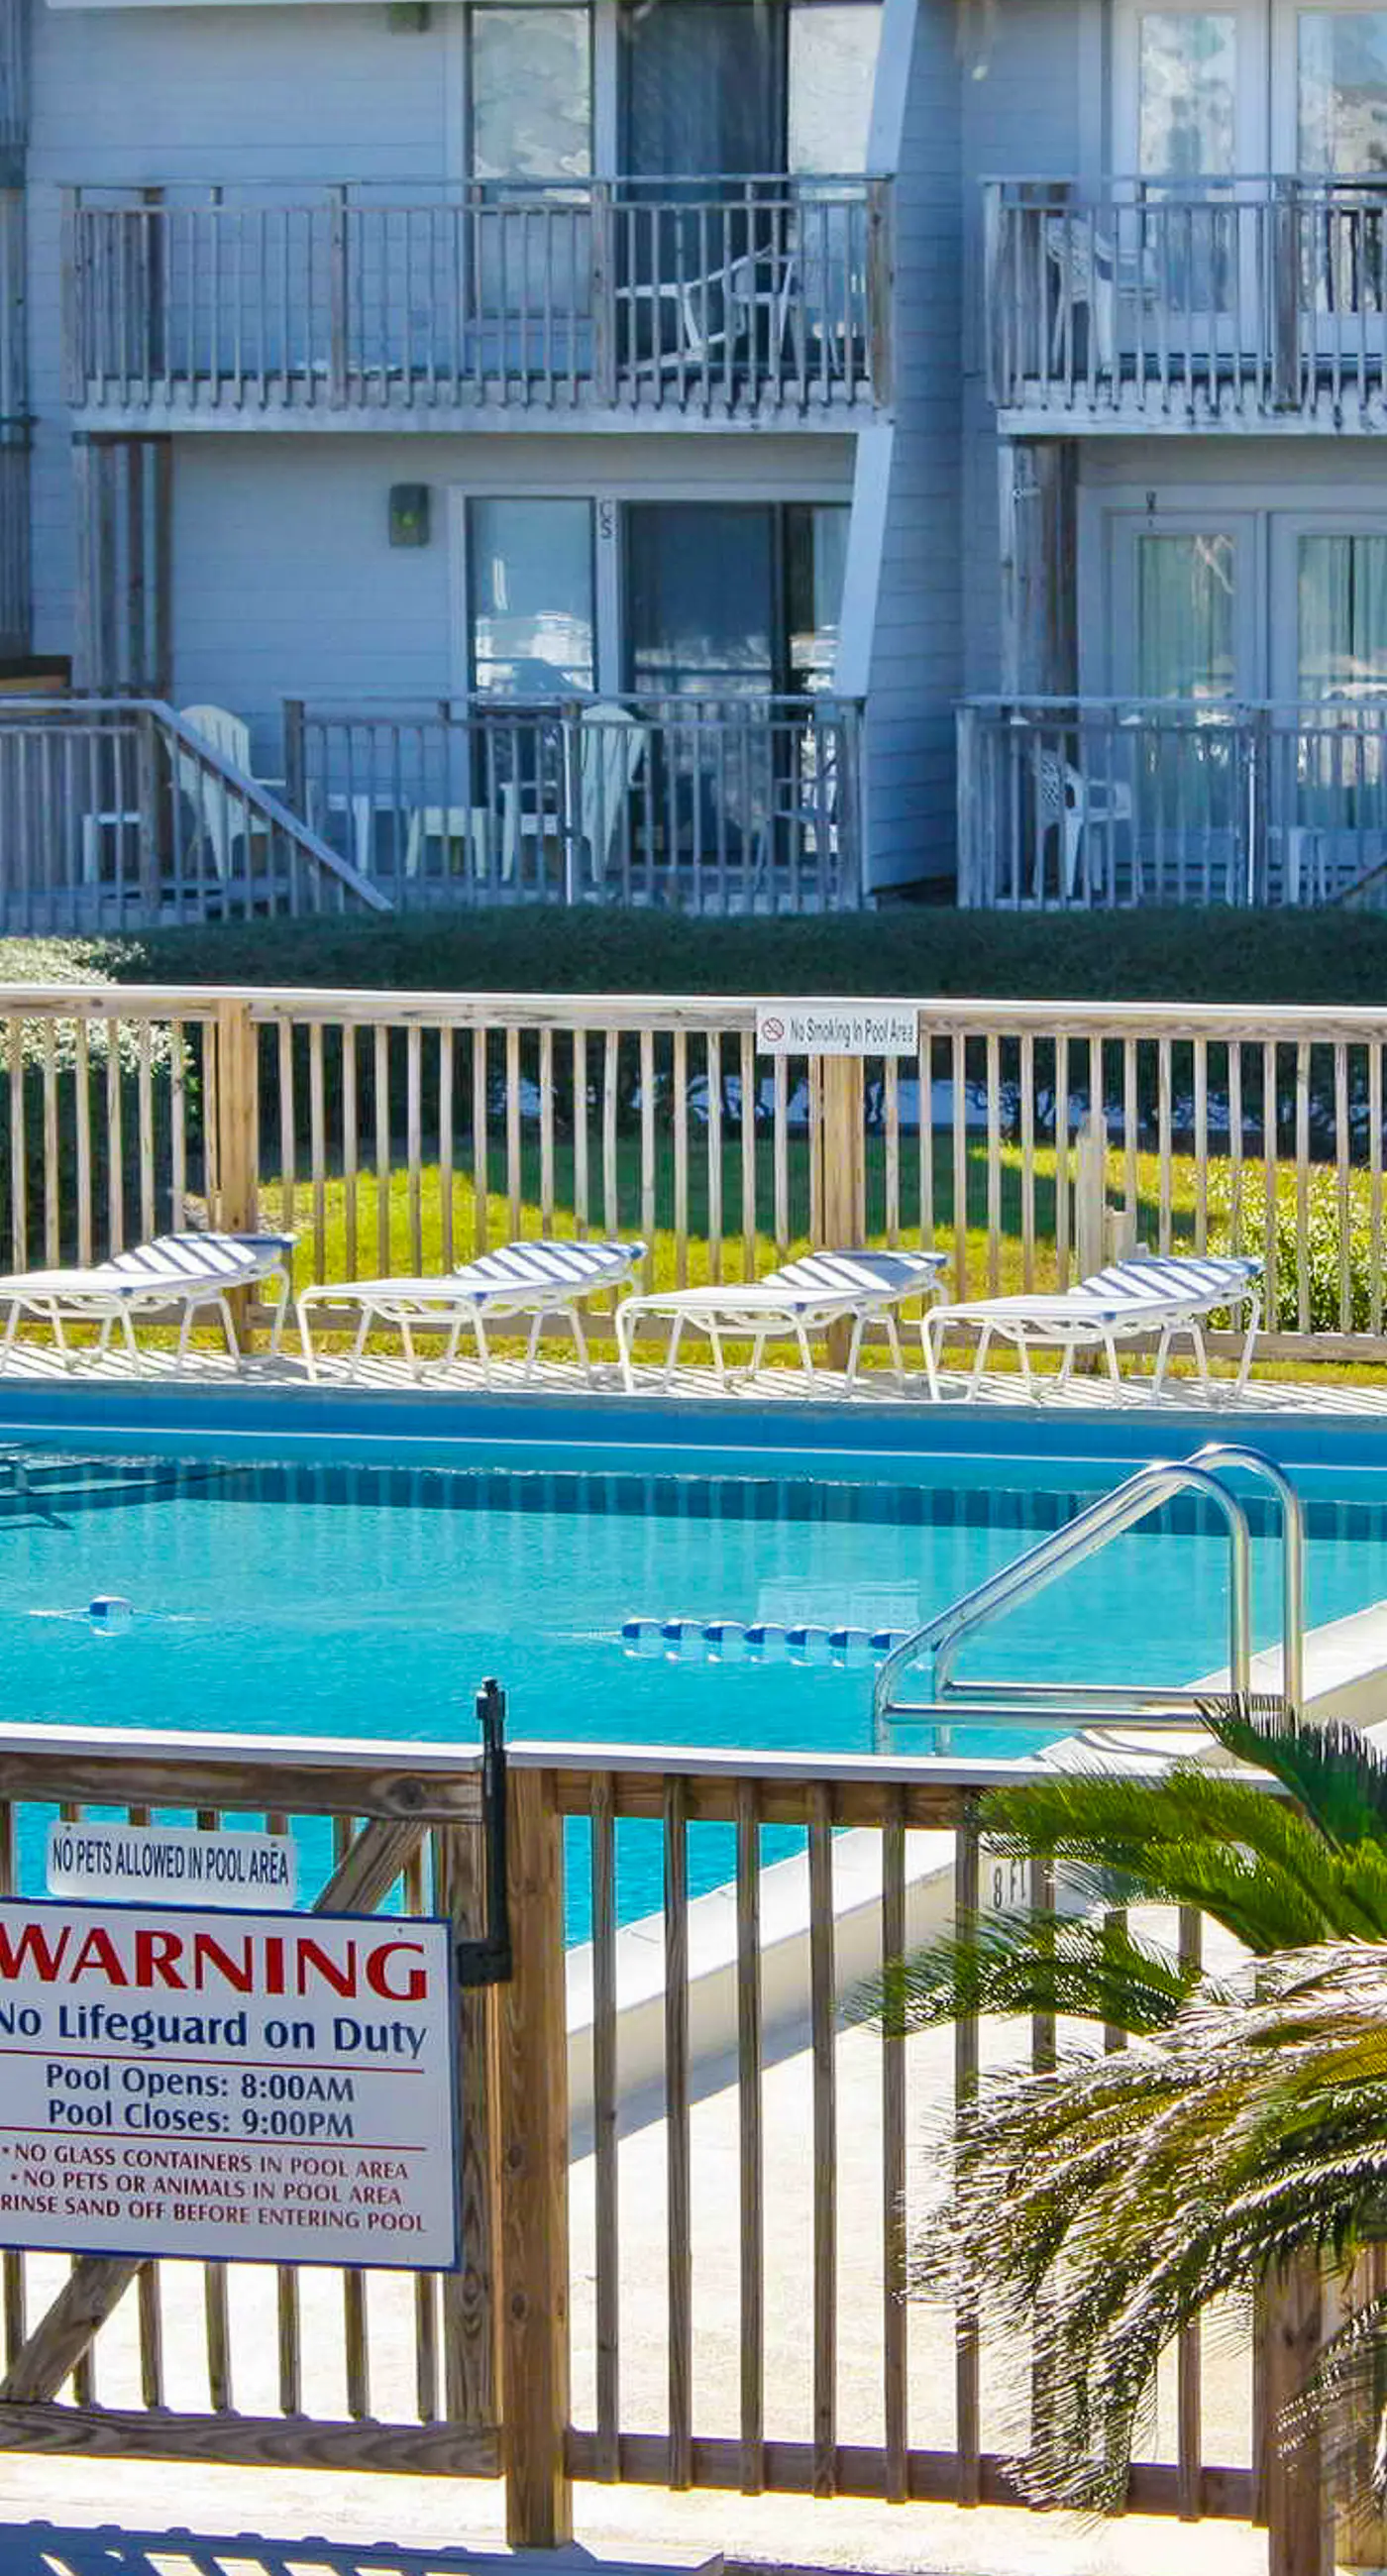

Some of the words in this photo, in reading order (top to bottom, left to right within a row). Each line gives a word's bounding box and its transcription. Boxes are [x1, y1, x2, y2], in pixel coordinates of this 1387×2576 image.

[791, 1018, 805, 1042] No
[806, 1018, 851, 1047] Smoking
[853, 1018, 864, 1041] In
[865, 1019, 889, 1042] Pool
[891, 1019, 913, 1042] Area
[53, 1838, 72, 1873] NO
[76, 1841, 112, 1875] PETS
[115, 1843, 185, 1878] ALLOWED
[188, 1847, 202, 1879] IN
[206, 1848, 246, 1882] POOL
[248, 1850, 289, 1884] AREA
[994, 1867, 1003, 1908] 8
[0, 1922, 427, 2001] WARNING
[0, 2002, 42, 2037] No
[58, 2003, 247, 2050] Lifeguard
[265, 2023, 315, 2050] on
[334, 2017, 427, 2060] Duty
[46, 2064, 109, 2091] Pool
[122, 2067, 229, 2098] Opens:
[240, 2073, 355, 2102] 8:00AM
[49, 2099, 112, 2127] Pool
[124, 2102, 230, 2133] Closes:
[242, 2108, 355, 2138] 9:00PM
[14, 2143, 47, 2163] NO
[54, 2145, 116, 2166] GLASS
[123, 2149, 253, 2174] CONTAINERS
[260, 2156, 283, 2174] IN
[290, 2157, 349, 2178] POOL
[356, 2160, 409, 2181] AREA
[23, 2170, 55, 2189] NO
[62, 2171, 109, 2192] PETS
[116, 2175, 147, 2193] OR
[153, 2177, 246, 2199] ANIMALS
[253, 2182, 275, 2200] IN
[283, 2183, 342, 2202] POOL
[349, 2186, 402, 2205] AREA
[0, 2194, 58, 2214] RINSE
[64, 2197, 121, 2217] SAND
[128, 2200, 166, 2220] OFF
[172, 2203, 252, 2225] BEFORE
[258, 2207, 361, 2229] ENTERING
[368, 2211, 427, 2233] POOL
